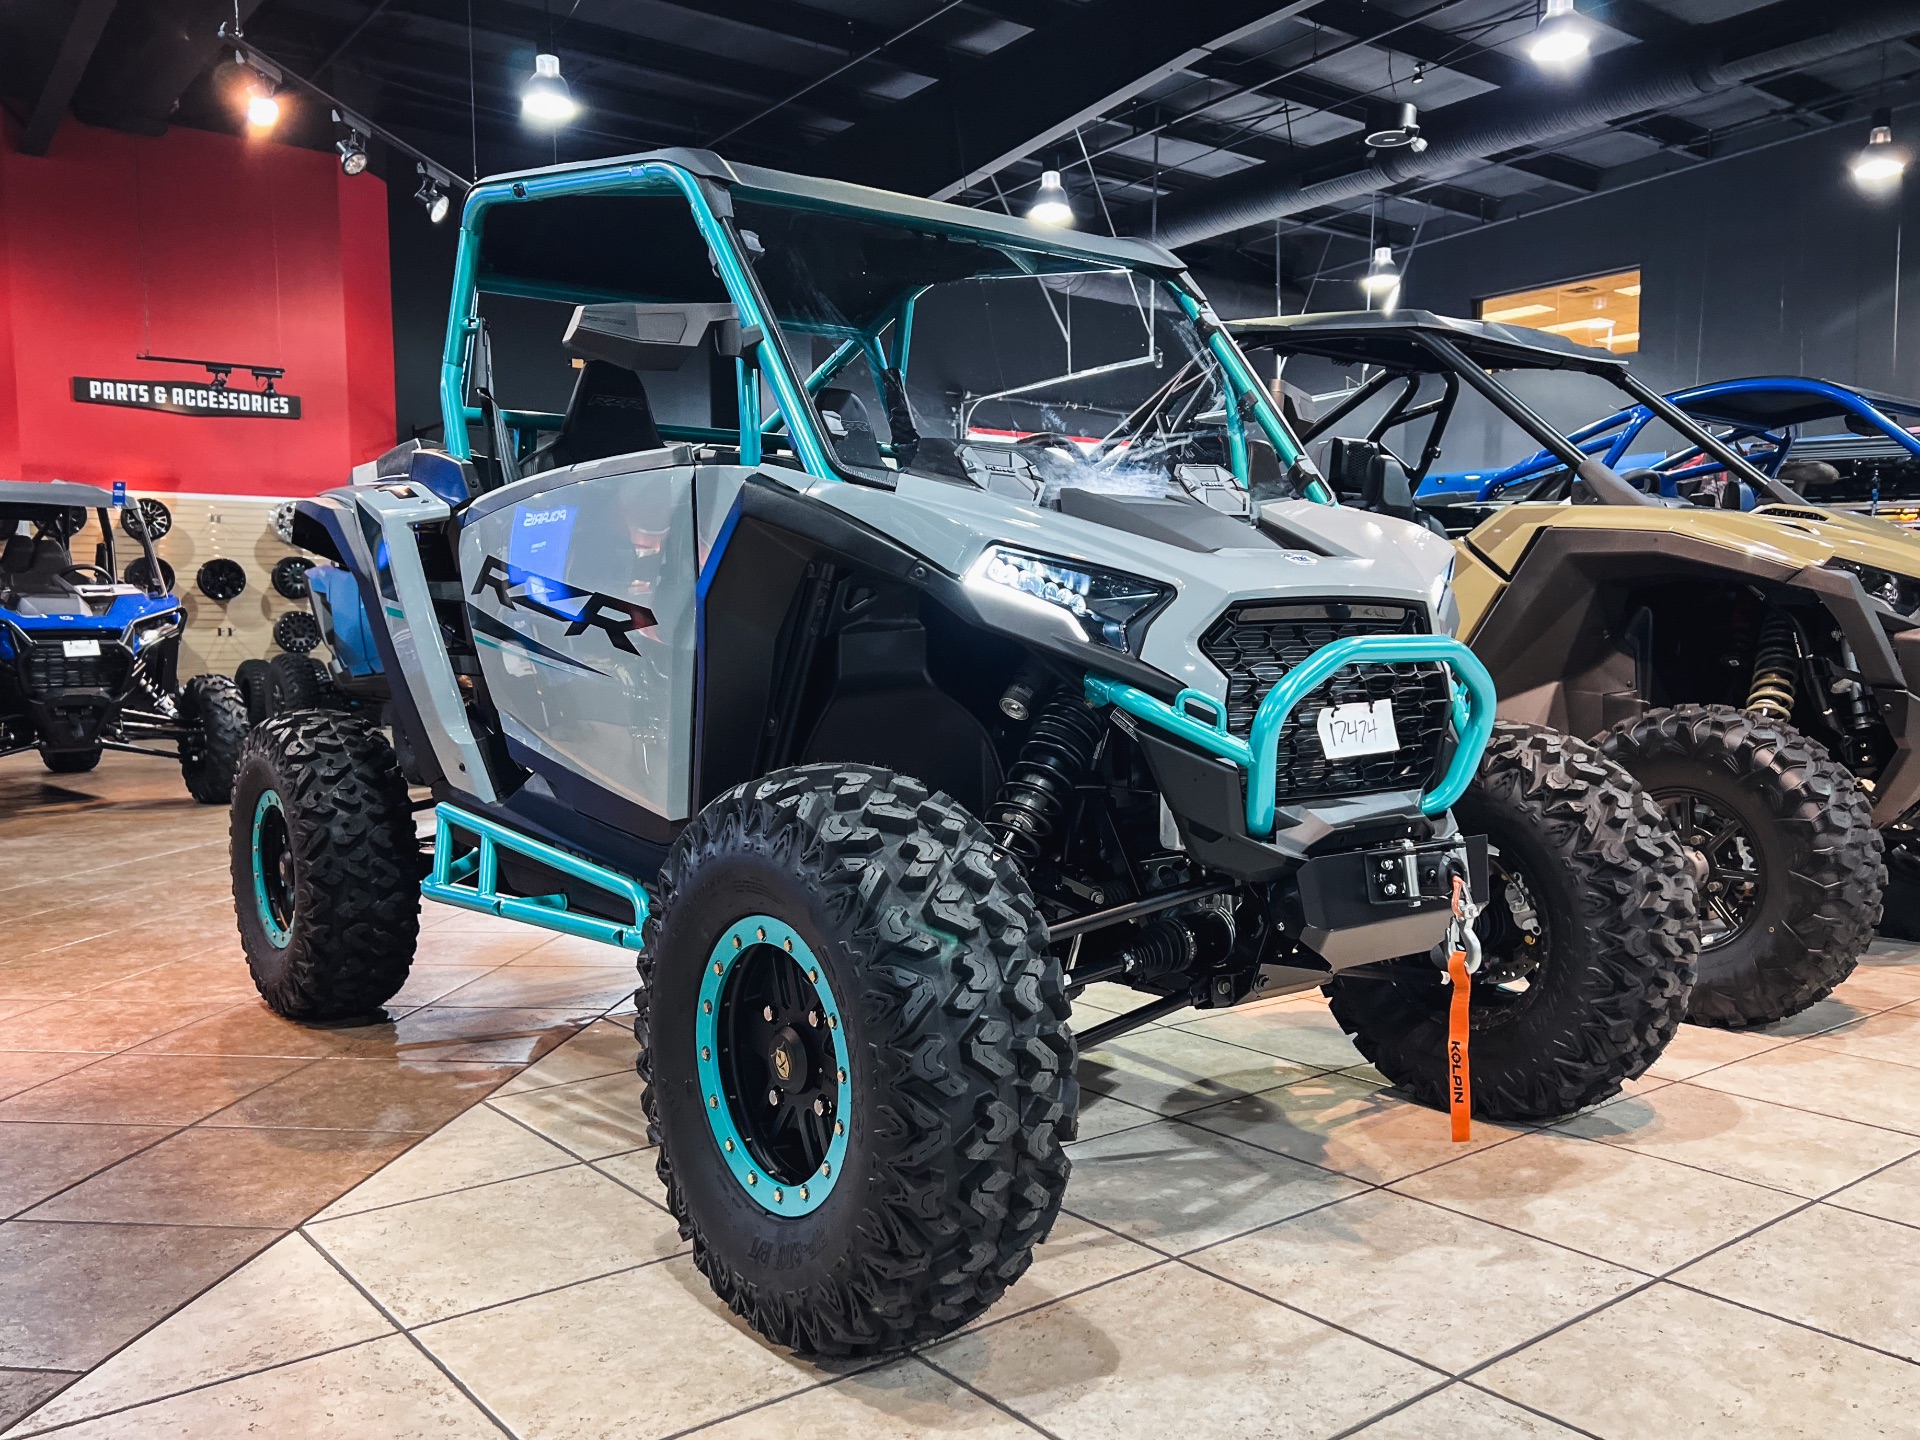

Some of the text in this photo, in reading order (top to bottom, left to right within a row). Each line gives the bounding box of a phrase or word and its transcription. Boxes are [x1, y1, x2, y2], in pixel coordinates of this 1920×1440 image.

[90, 381, 290, 415] PARTS & ACCESSORIES
[471, 554, 659, 657] RZR
[1329, 718, 1378, 747] 17474
[1450, 1040, 1465, 1104] KOLPIN
